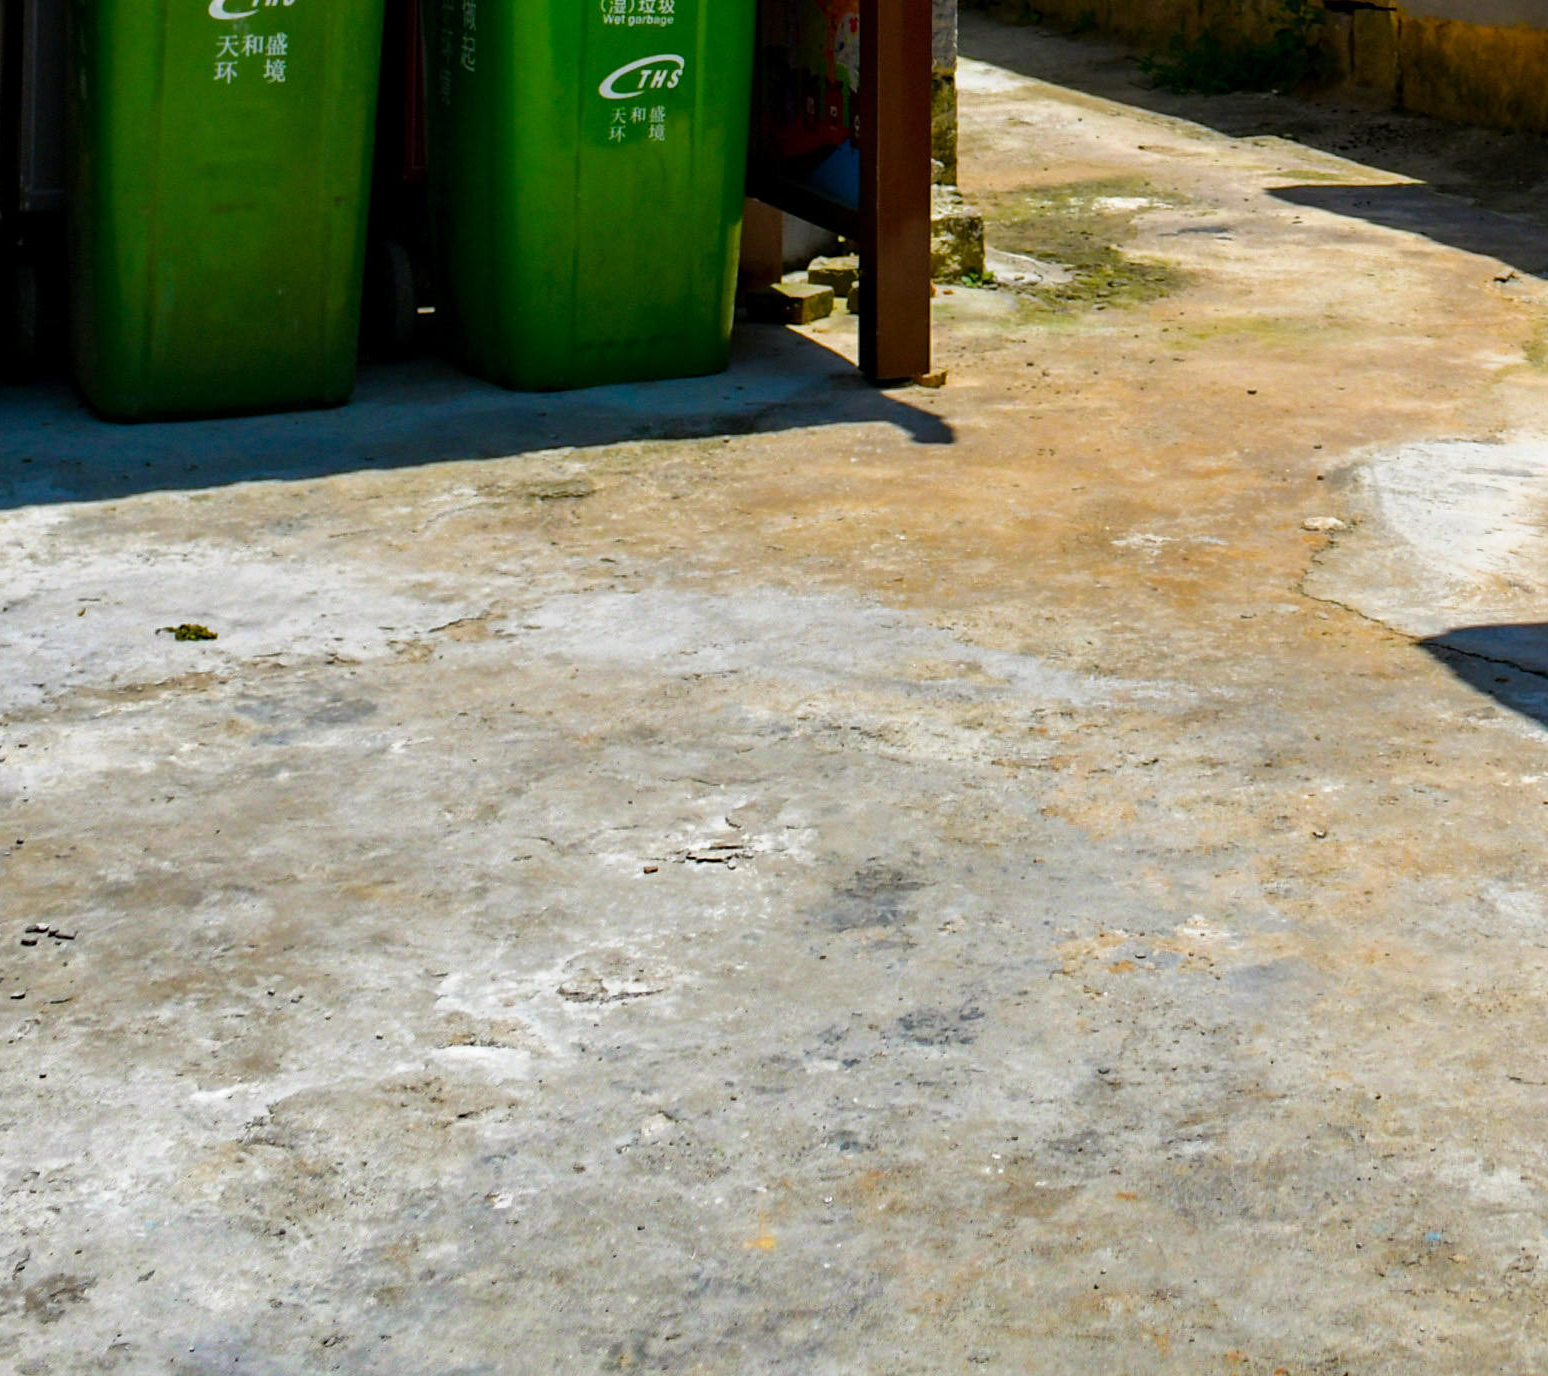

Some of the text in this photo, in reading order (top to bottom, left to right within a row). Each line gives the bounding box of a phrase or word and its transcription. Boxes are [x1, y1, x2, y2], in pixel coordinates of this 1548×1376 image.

[603, 14, 675, 27] Wet garbage
[215, 32, 289, 59] 天和盛
[213, 58, 287, 85] 环境
[637, 69, 684, 90] THS
[611, 104, 667, 125] 天和盛
[608, 124, 666, 143] 环境
